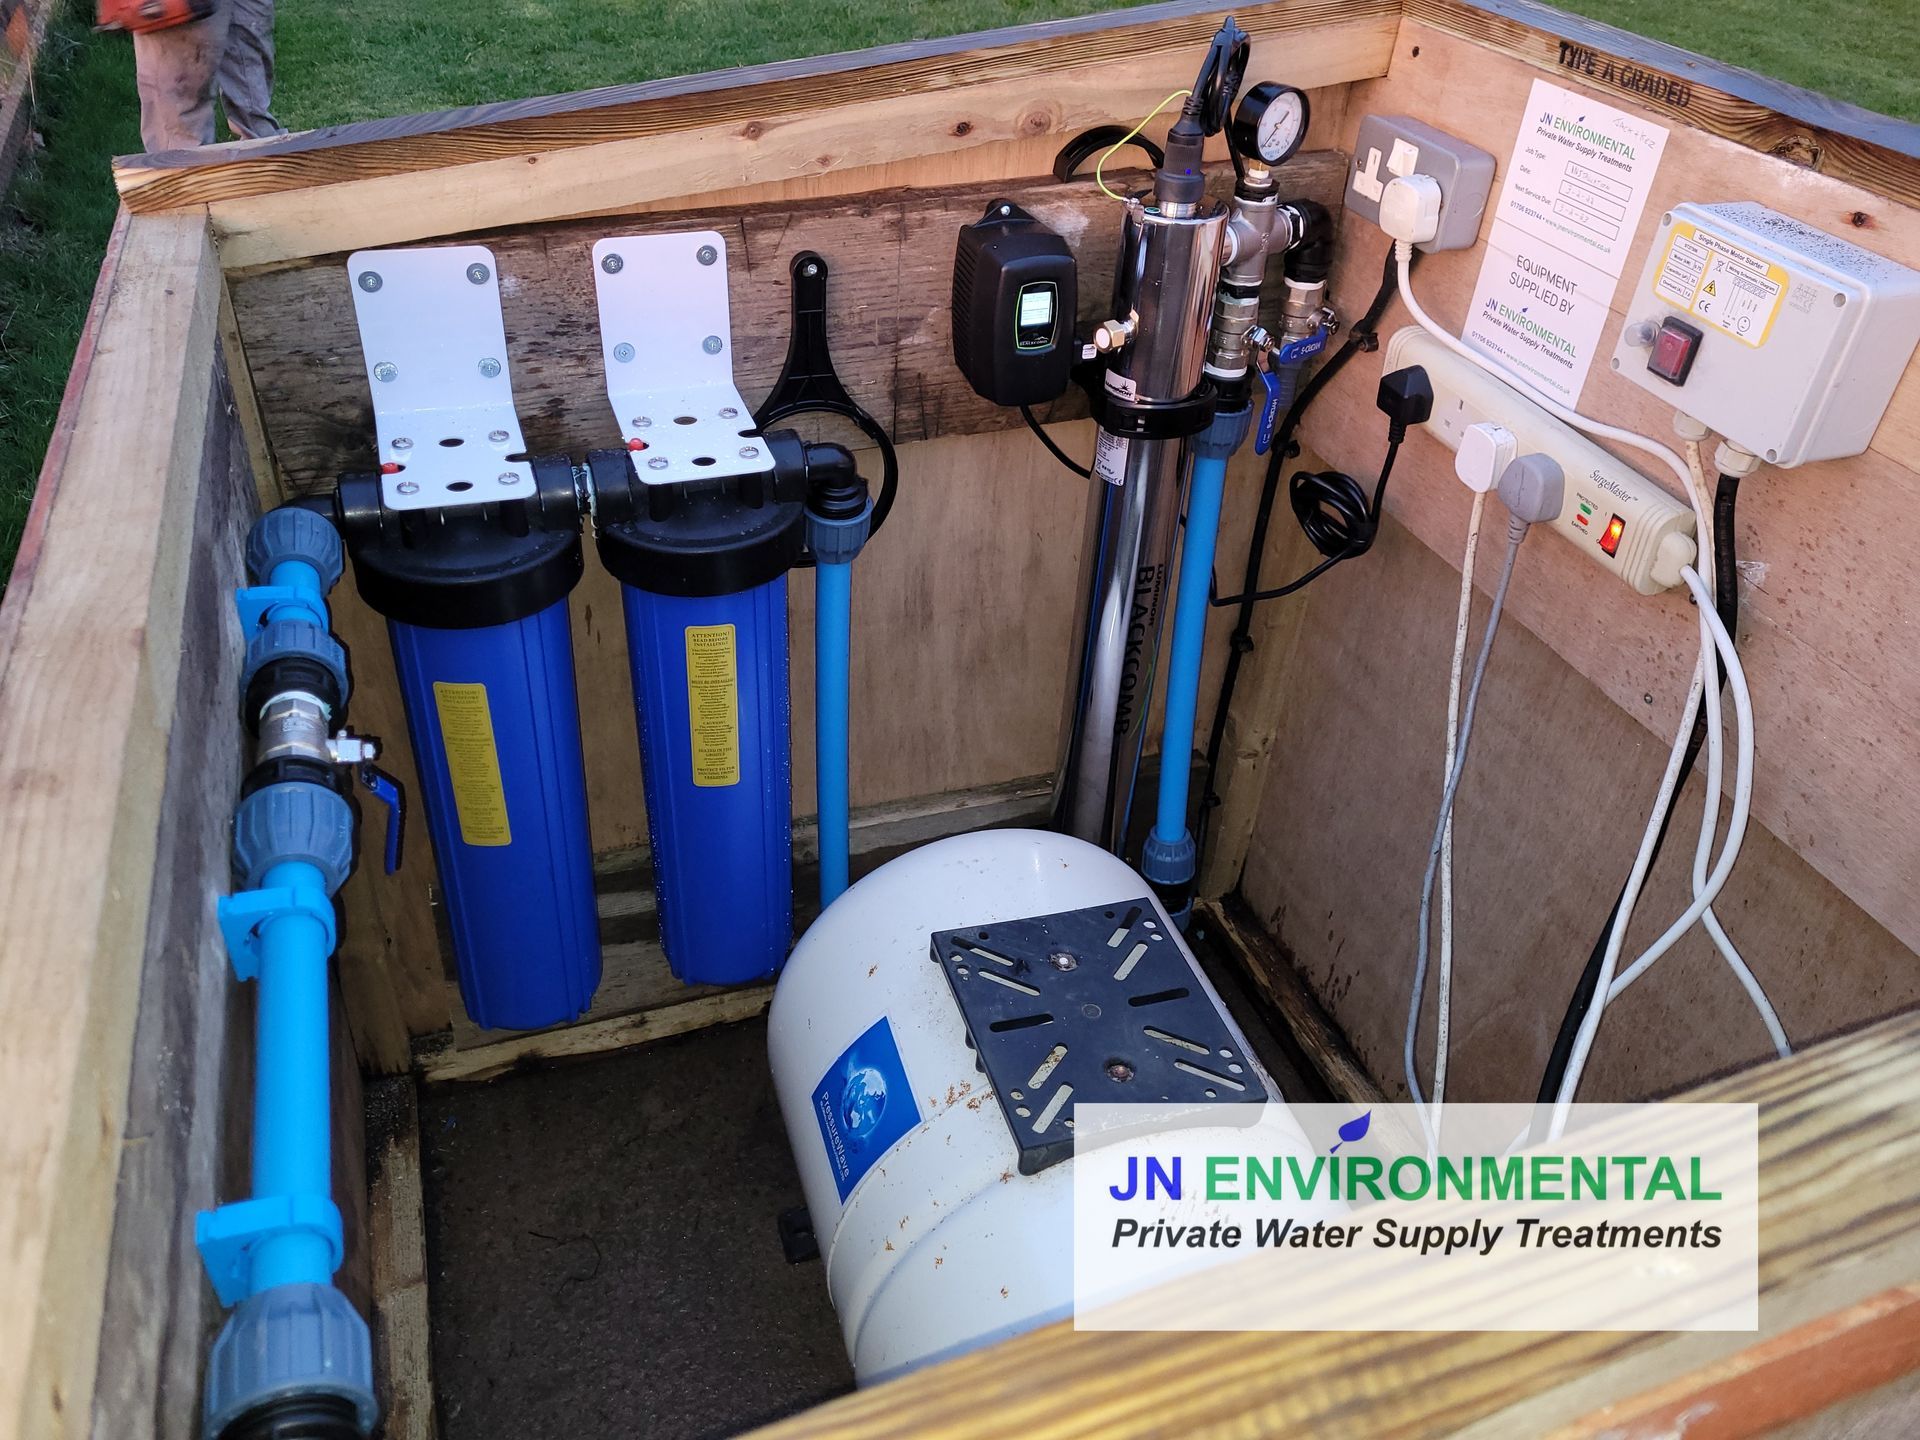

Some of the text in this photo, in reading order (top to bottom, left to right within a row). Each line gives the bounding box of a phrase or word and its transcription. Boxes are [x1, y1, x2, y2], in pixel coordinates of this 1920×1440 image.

[1559, 40, 1690, 107] TYPE A GRADED
[1526, 146, 1546, 160] Job Type:
[1536, 126, 1632, 172] Private Water Supply Treatments
[1540, 112, 1636, 160] JN ENVIRONMENTAL
[1520, 164, 1532, 174] Date:
[1510, 200, 1525, 212] 01706
[1525, 207, 1542, 220] 823744
[1514, 183, 1552, 206] Next Service Due:
[1698, 234, 1764, 270] Single Phase Motor Starter
[1509, 272, 1575, 316] SUPPLIED BY
[1516, 254, 1578, 296] EQUIPMENT
[1482, 310, 1574, 368] Private Water Supply Treatments
[1486, 298, 1576, 358] JN ENVIRONMENTAL
[1486, 338, 1504, 354] 823744
[1576, 492, 1598, 510] PROTECTED
[1148, 564, 1164, 626] LUMINOR
[1114, 565, 1156, 736] BLACKCOMB
[822, 1091, 850, 1178] PressureWave
